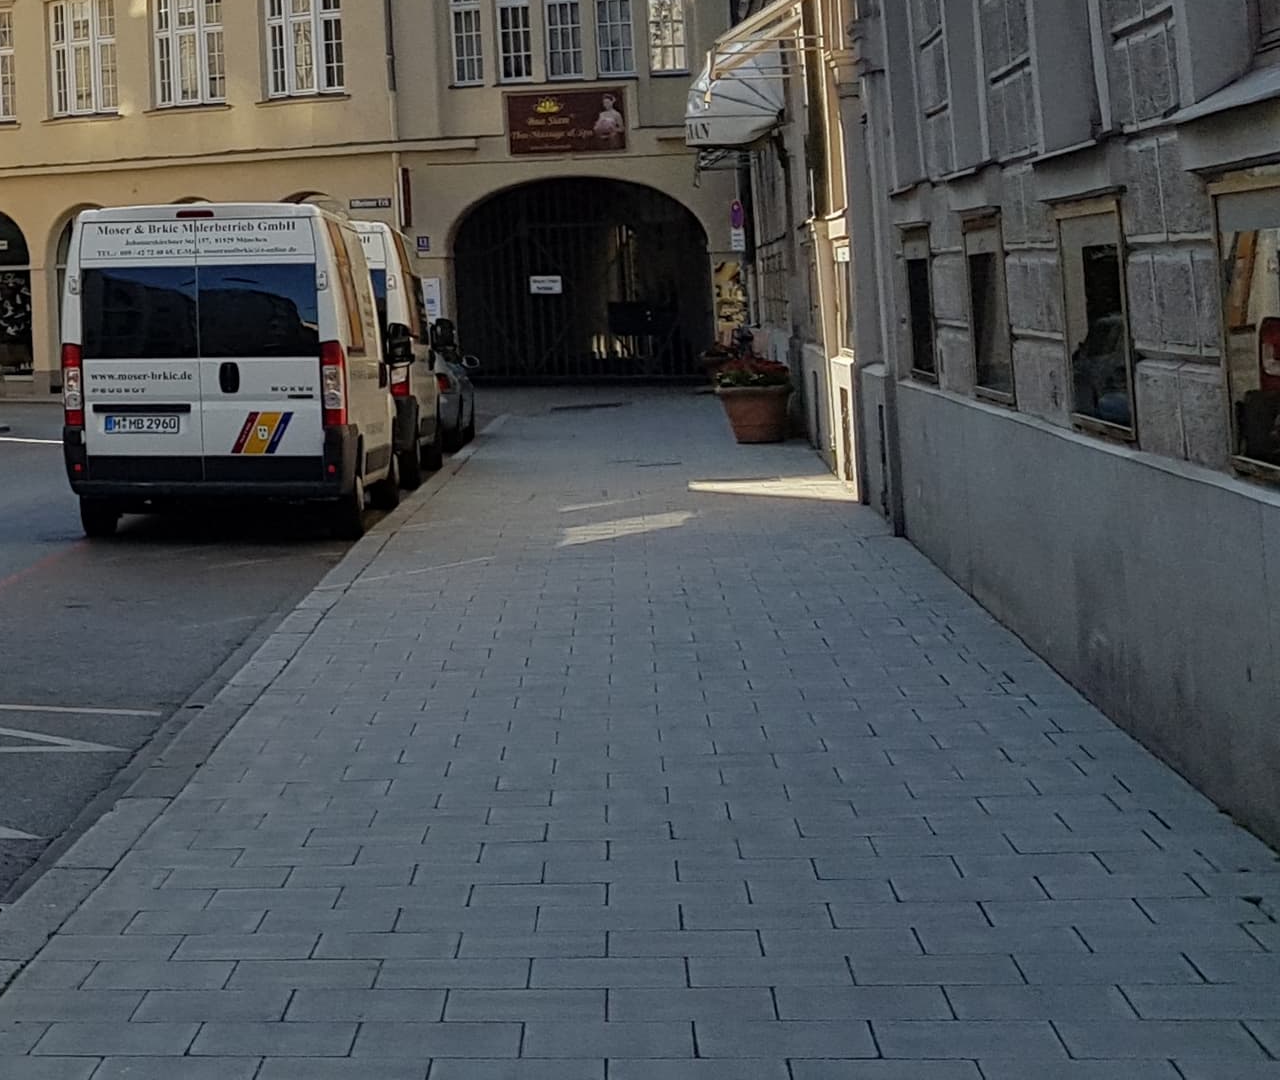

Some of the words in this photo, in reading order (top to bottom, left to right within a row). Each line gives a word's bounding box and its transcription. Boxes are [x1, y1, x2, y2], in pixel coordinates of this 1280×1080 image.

[96, 225, 132, 236] Moser
[134, 224, 145, 235] &
[257, 220, 296, 231] GmbH
[90, 370, 193, 381] www.moser-brkic.de
[146, 418, 177, 430] 2960
